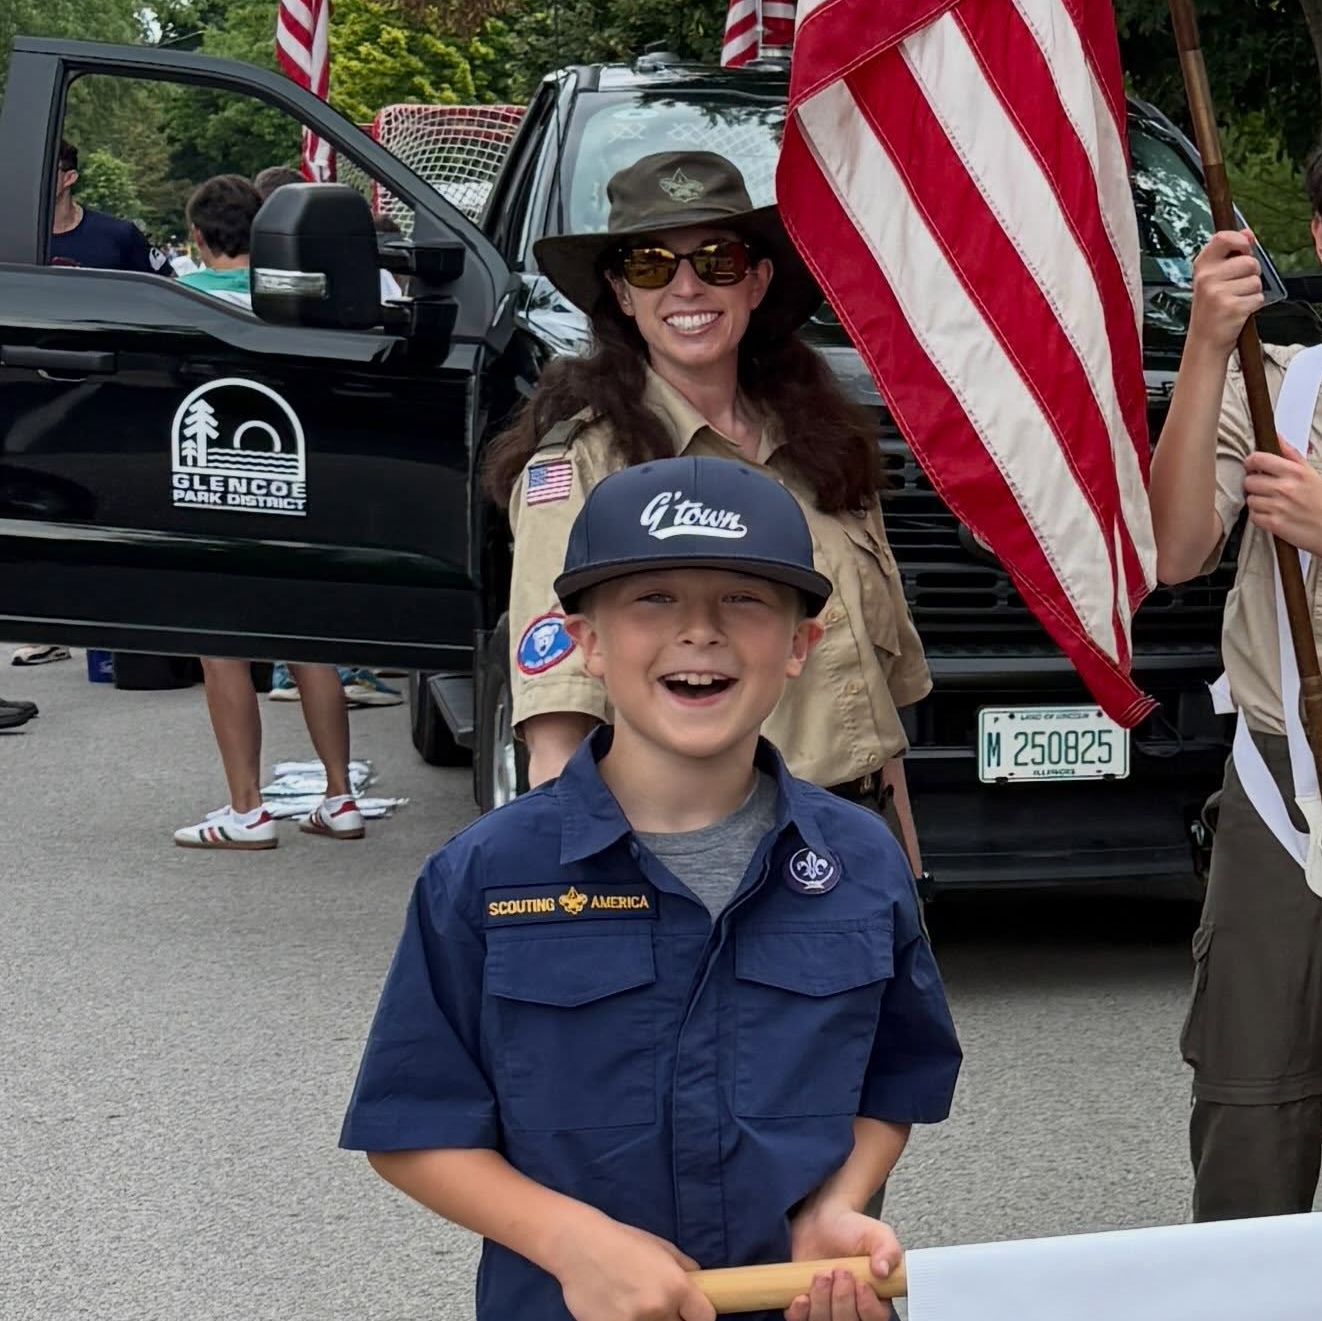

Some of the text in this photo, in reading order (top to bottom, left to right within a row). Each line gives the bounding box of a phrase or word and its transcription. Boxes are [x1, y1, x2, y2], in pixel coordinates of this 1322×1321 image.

[172, 473, 307, 498] GLENCOE
[173, 489, 307, 510] PARK DISTRICT
[640, 490, 748, 540] G'town
[987, 729, 1113, 768] M 250825
[488, 895, 650, 916] SCOUTING AMERICA
